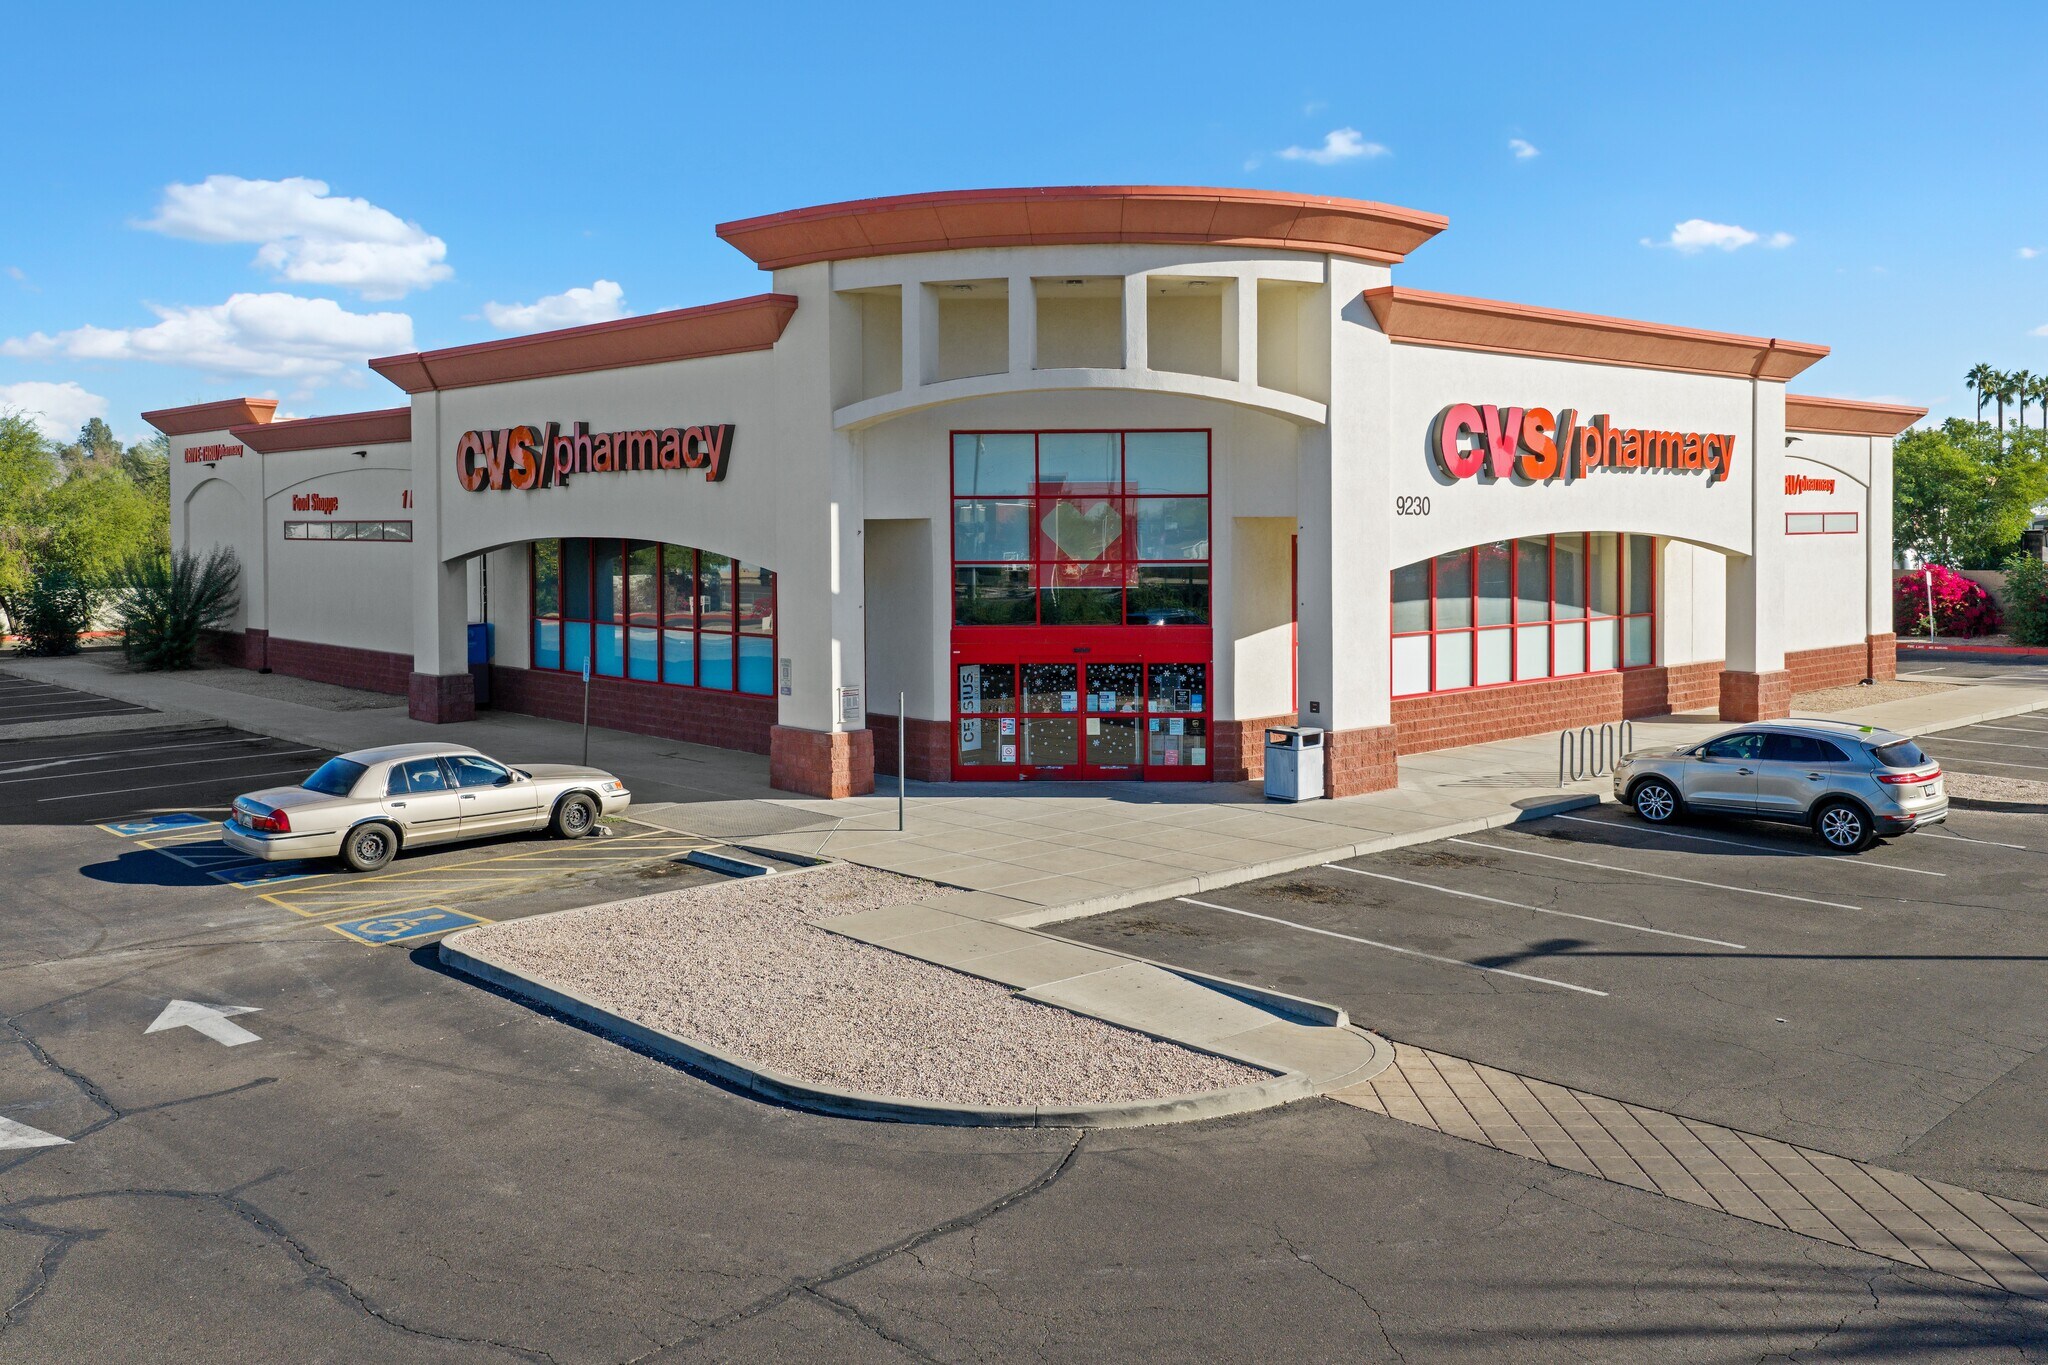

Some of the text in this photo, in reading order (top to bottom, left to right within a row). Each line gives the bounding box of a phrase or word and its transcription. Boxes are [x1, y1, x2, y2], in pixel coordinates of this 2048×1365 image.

[456, 421, 736, 492] CVS/pharmacy
[1433, 402, 1736, 482] CVS/pharmacy
[292, 493, 339, 515] Food Shoppe
[1396, 495, 1431, 517] 9230
[962, 673, 975, 743] CESIUS
